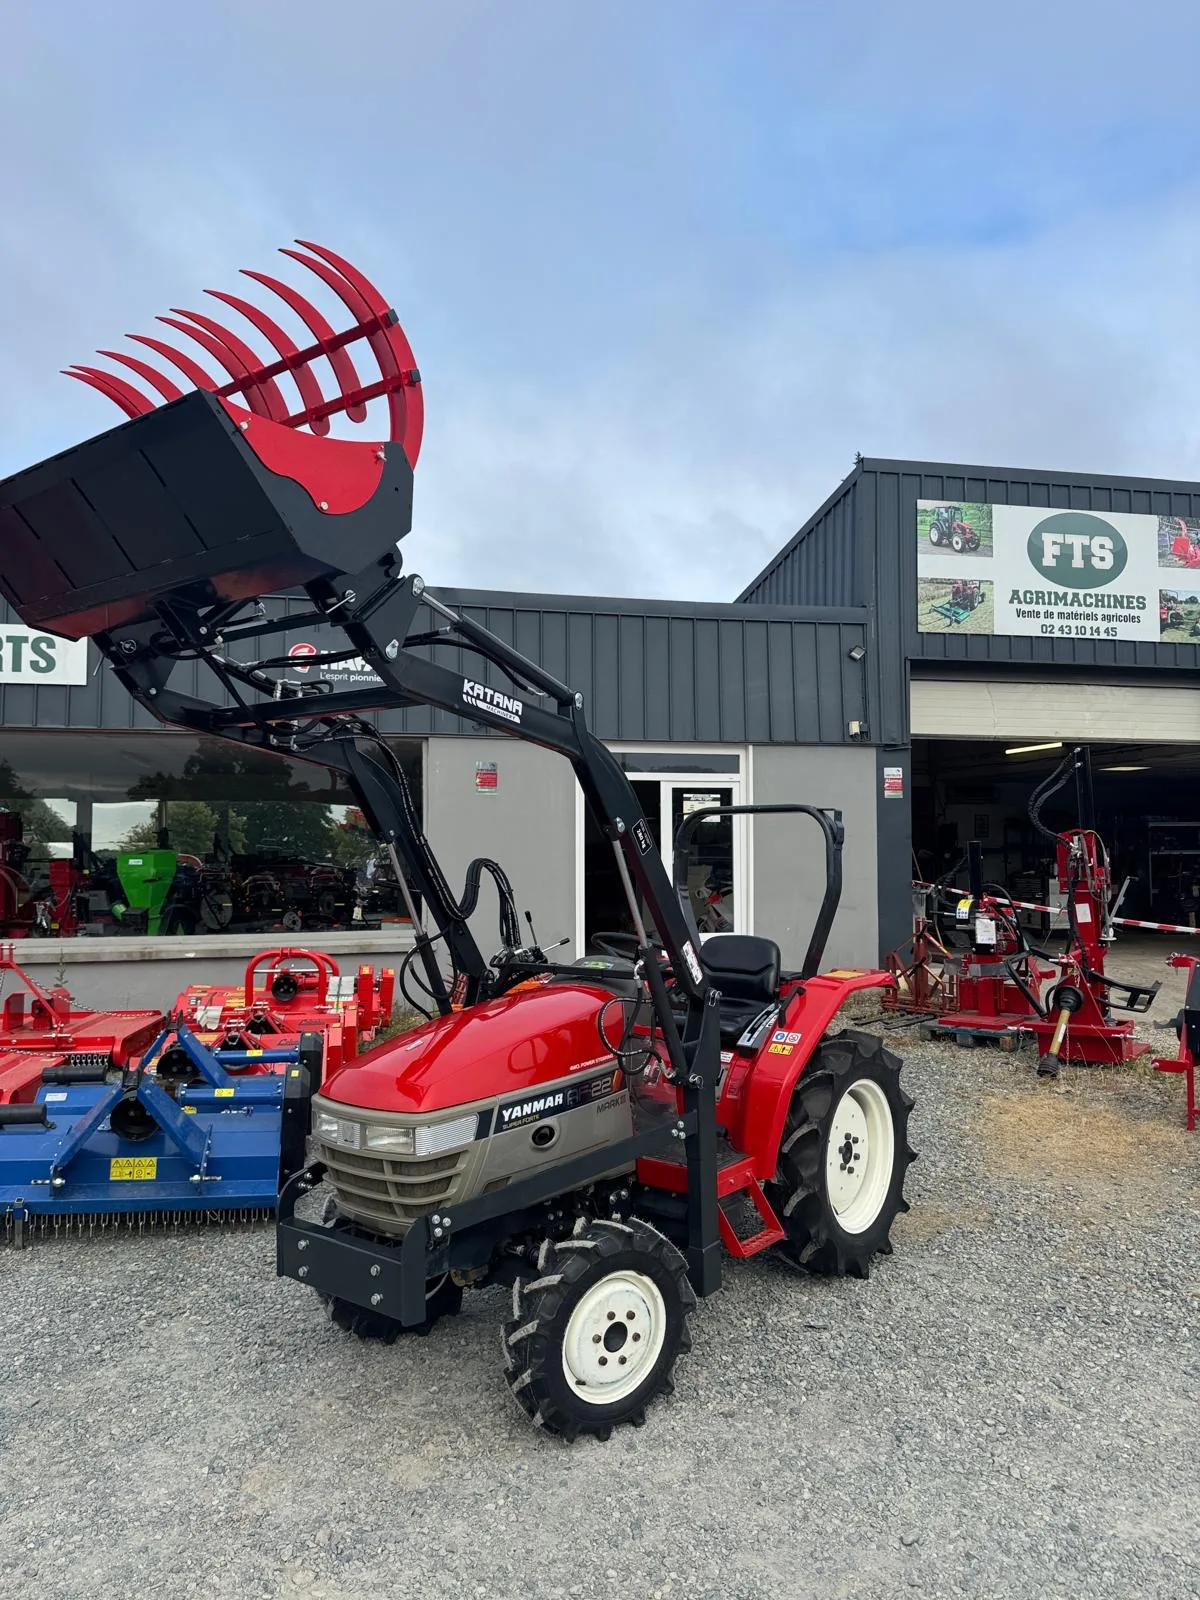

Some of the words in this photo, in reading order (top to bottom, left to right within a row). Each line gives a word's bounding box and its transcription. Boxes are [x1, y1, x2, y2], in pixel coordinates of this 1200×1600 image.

[1041, 532, 1114, 570] FTS
[1009, 589, 1147, 610] AGRIMACHINES
[1016, 608, 1041, 619] Vente
[1043, 609, 1055, 620] de
[1057, 610, 1099, 622] matériels
[1101, 612, 1141, 624] agricoles
[1041, 624, 1055, 635] 02
[1058, 624, 1072, 635] 43
[1075, 625, 1087, 636] 10
[1089, 626, 1101, 637] 14
[1104, 626, 1118, 637] 45
[0, 635, 56, 674] TS
[319, 671, 349, 682] L'esprit
[350, 673, 384, 684] pionnie
[463, 678, 523, 715] KATANA
[502, 1093, 563, 1121] YANMAR
